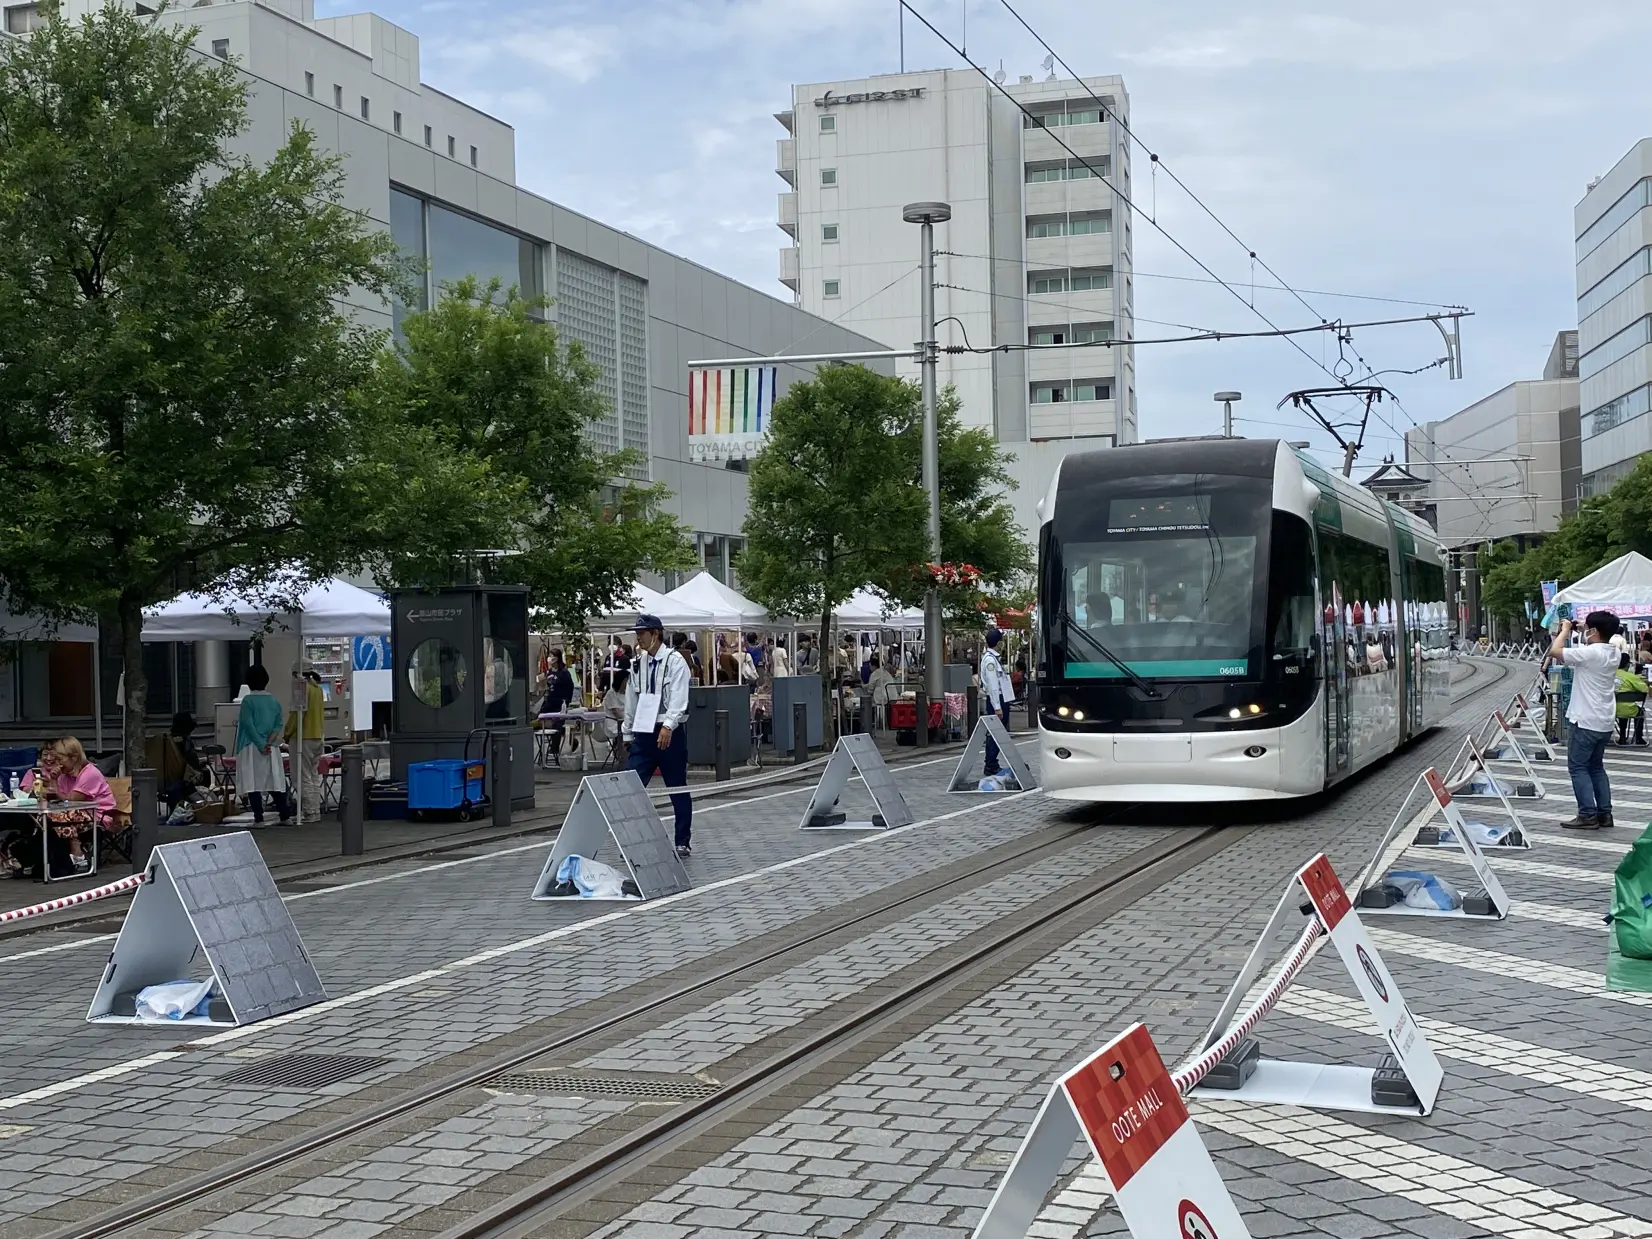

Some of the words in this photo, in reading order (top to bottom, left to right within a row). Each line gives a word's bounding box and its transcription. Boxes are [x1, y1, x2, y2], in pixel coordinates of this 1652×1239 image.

[689, 442, 741, 454] TOYAMA
[1219, 666, 1245, 675] 0605B
[1111, 1106, 1142, 1144] OOTE
[1136, 1087, 1164, 1121] MALL
